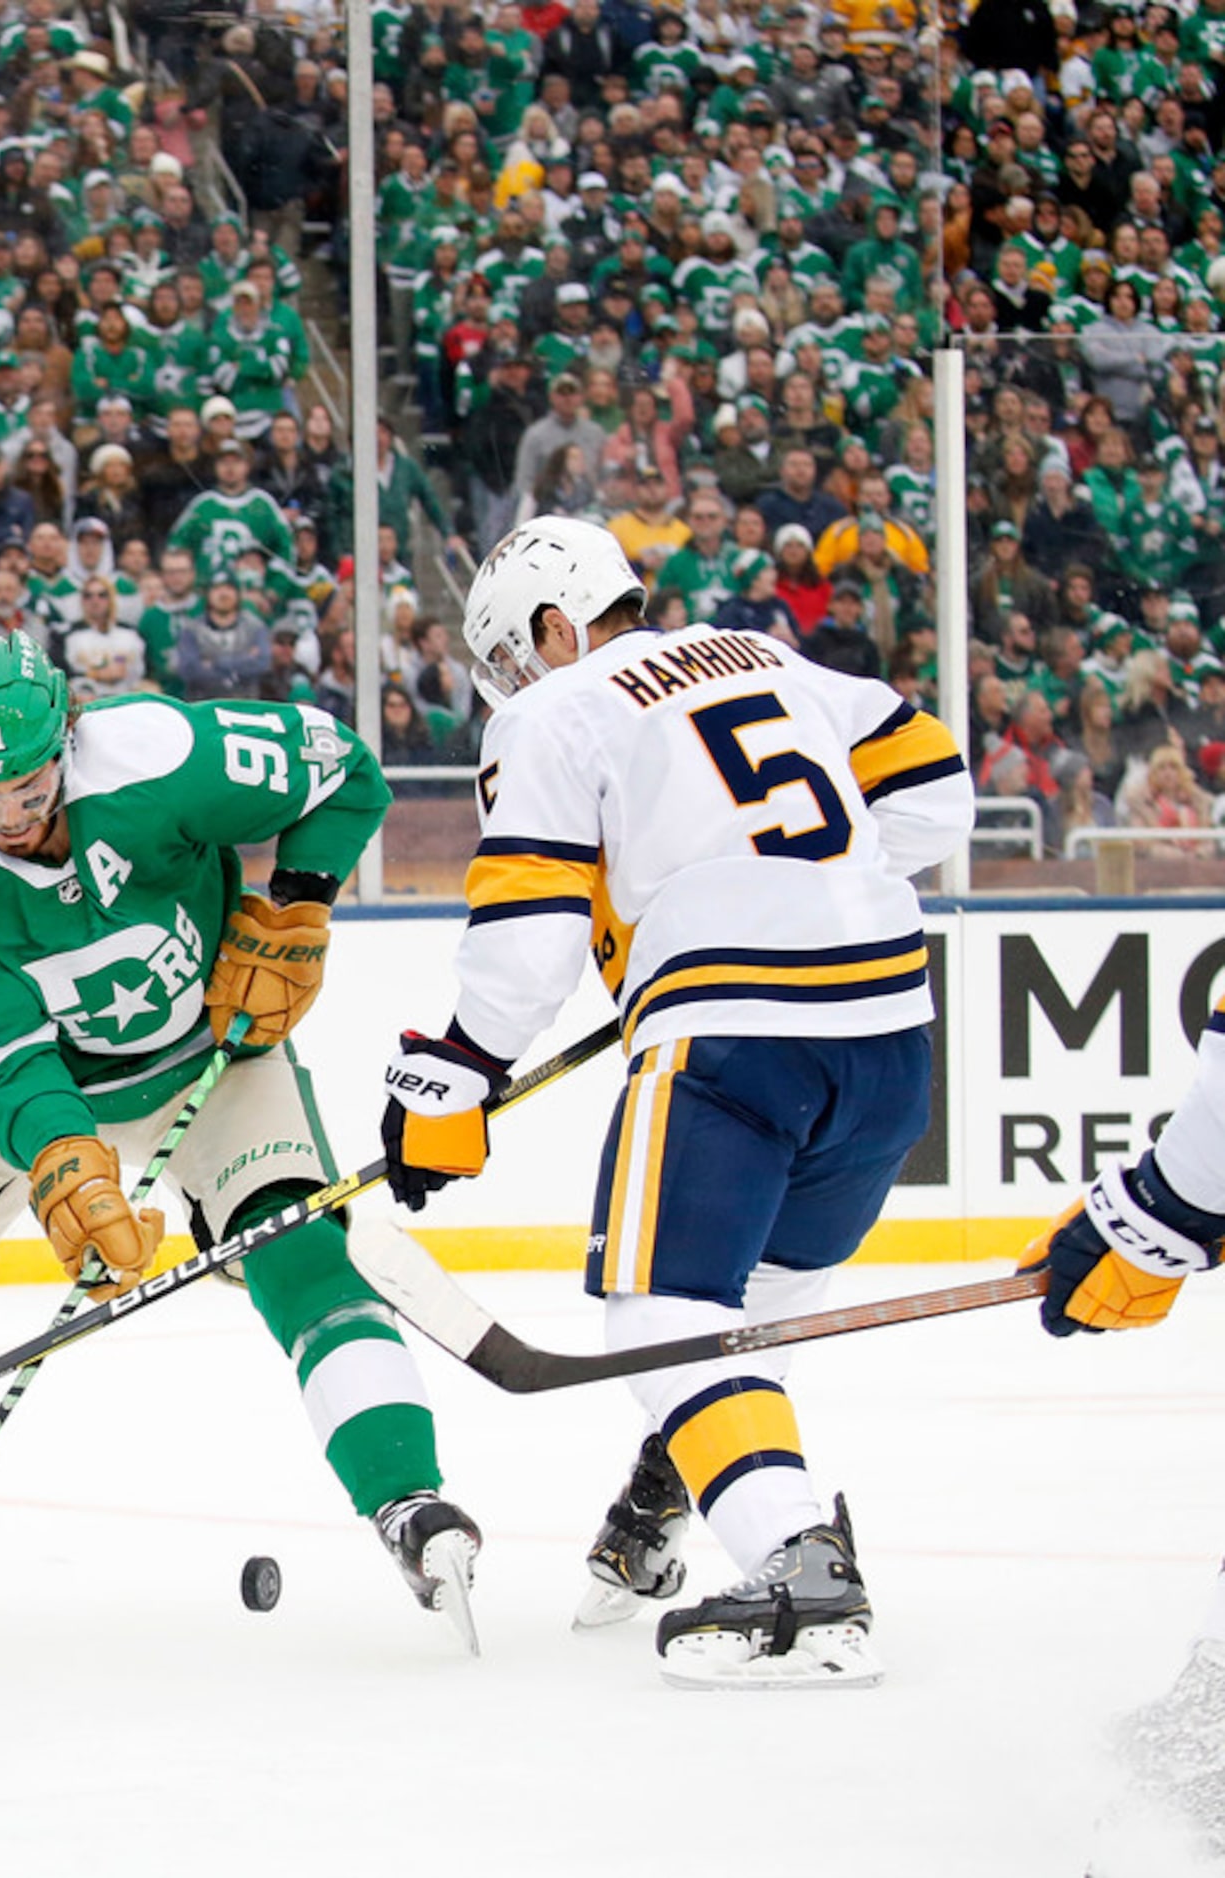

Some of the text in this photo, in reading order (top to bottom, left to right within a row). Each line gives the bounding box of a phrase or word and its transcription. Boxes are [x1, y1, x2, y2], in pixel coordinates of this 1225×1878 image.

[609, 635, 784, 709] HAMHUIS
[214, 707, 289, 794] 91
[686, 690, 853, 864] 5
[85, 839, 133, 909] A
[1000, 1110, 1175, 1185] RE
[1091, 1182, 1189, 1267] CCM
